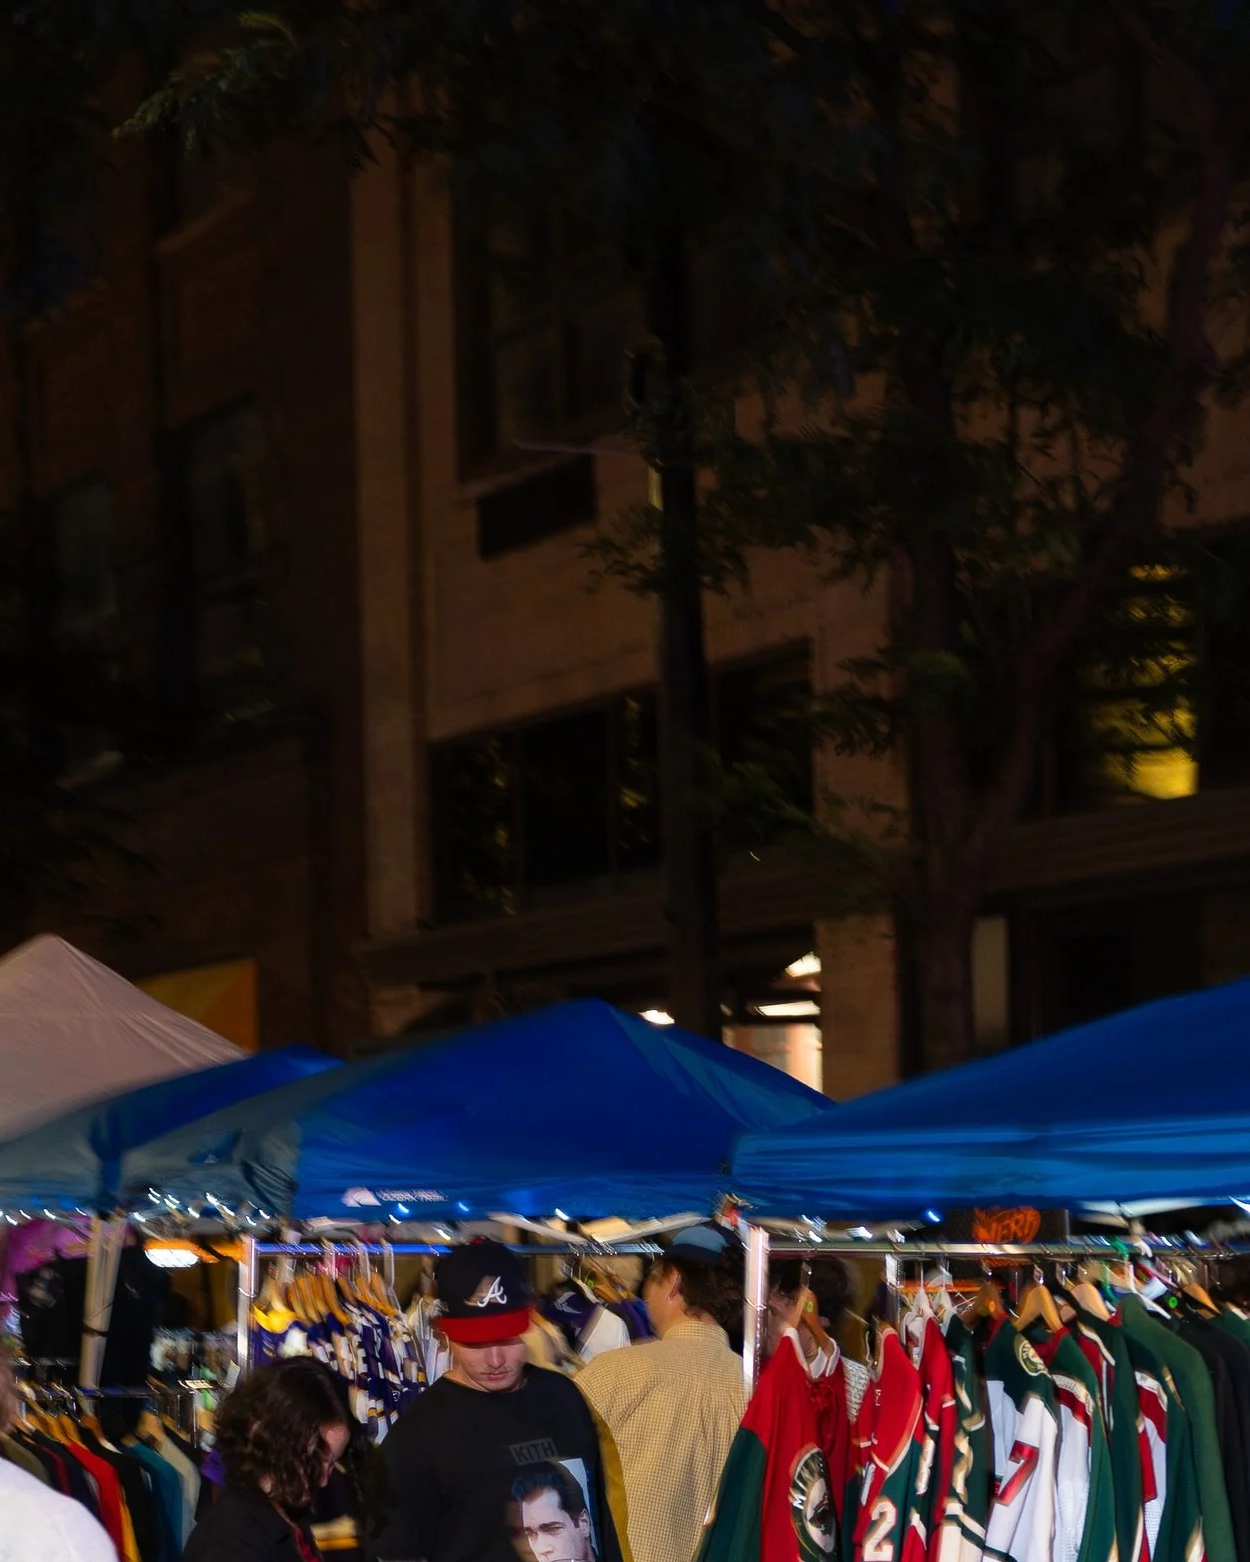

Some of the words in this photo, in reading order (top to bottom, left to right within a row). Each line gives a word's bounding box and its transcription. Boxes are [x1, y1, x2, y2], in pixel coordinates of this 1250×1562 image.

[476, 1276, 508, 1308] A
[512, 1440, 557, 1465] KITH
[993, 1440, 1039, 1507] 7
[863, 1496, 897, 1562] 2
